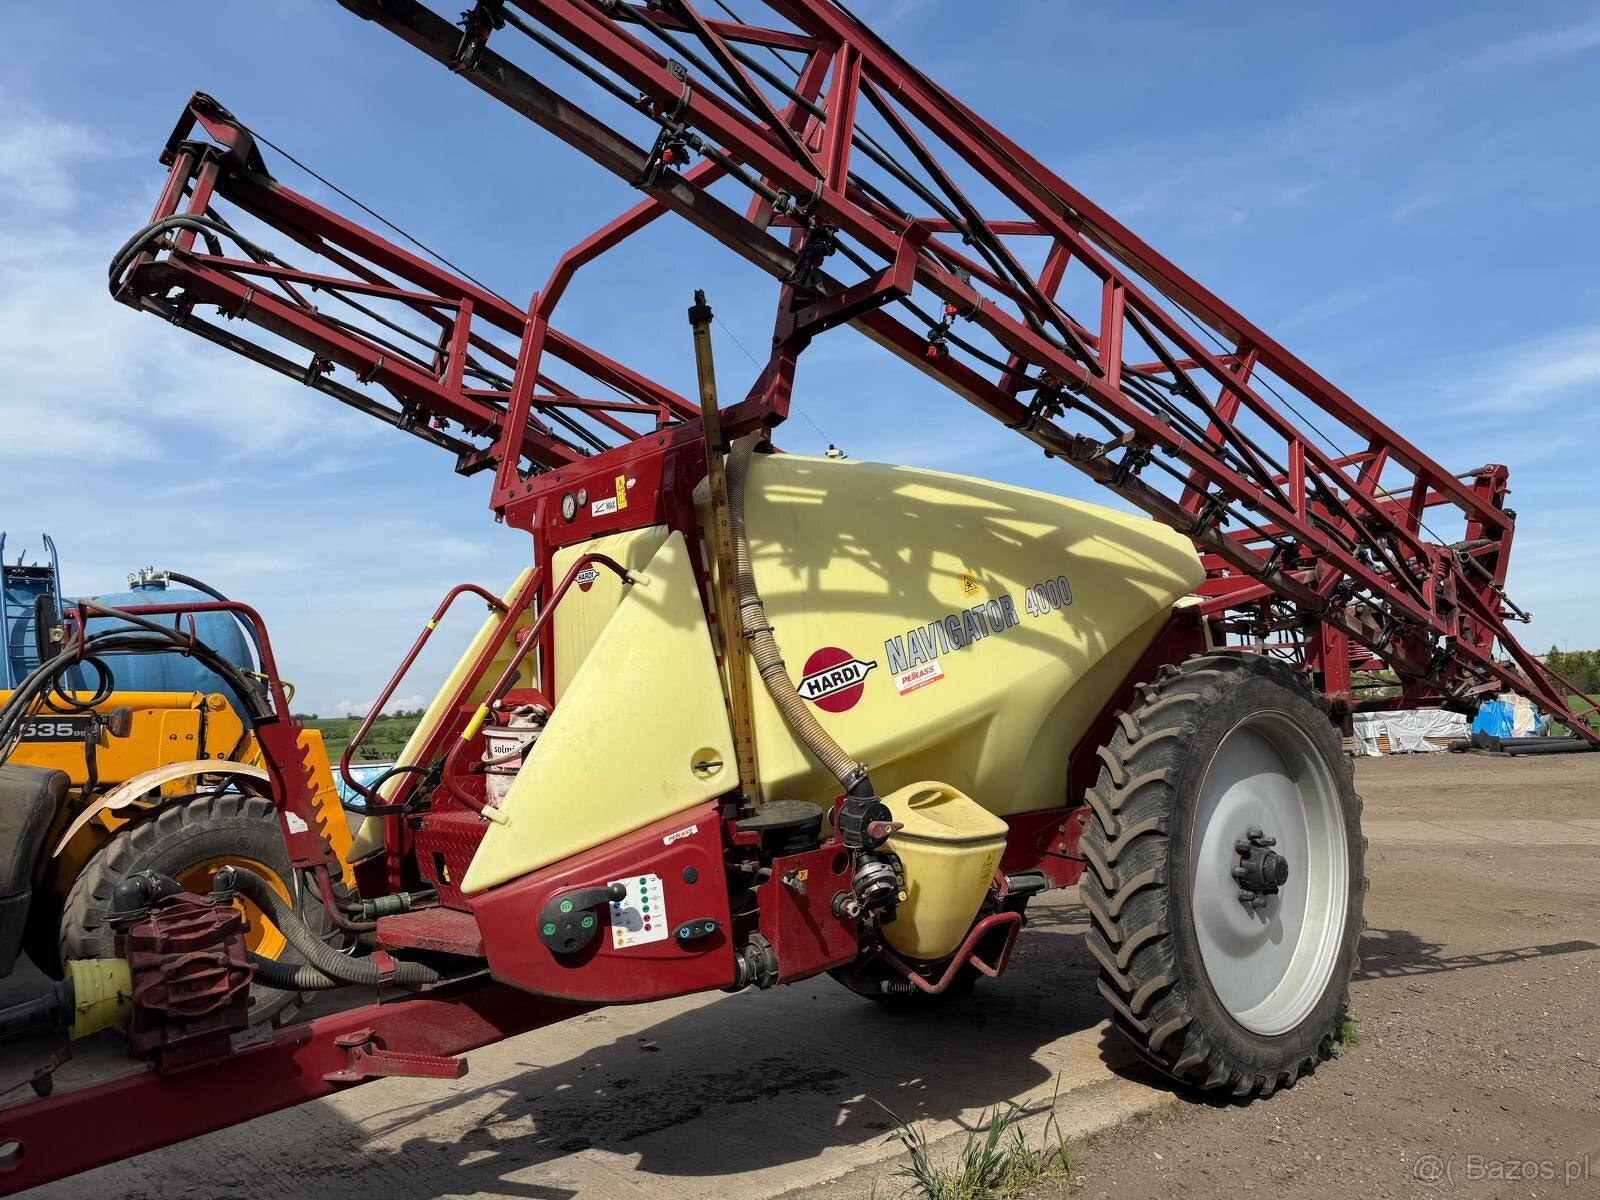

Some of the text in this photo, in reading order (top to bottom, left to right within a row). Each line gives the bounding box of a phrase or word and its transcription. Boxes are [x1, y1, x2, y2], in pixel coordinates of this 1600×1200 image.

[606, 500, 616, 510] MAX
[577, 571, 594, 581] HARDI
[884, 576, 1073, 675] NAVIGATOR 4000
[806, 664, 861, 696] HARDI
